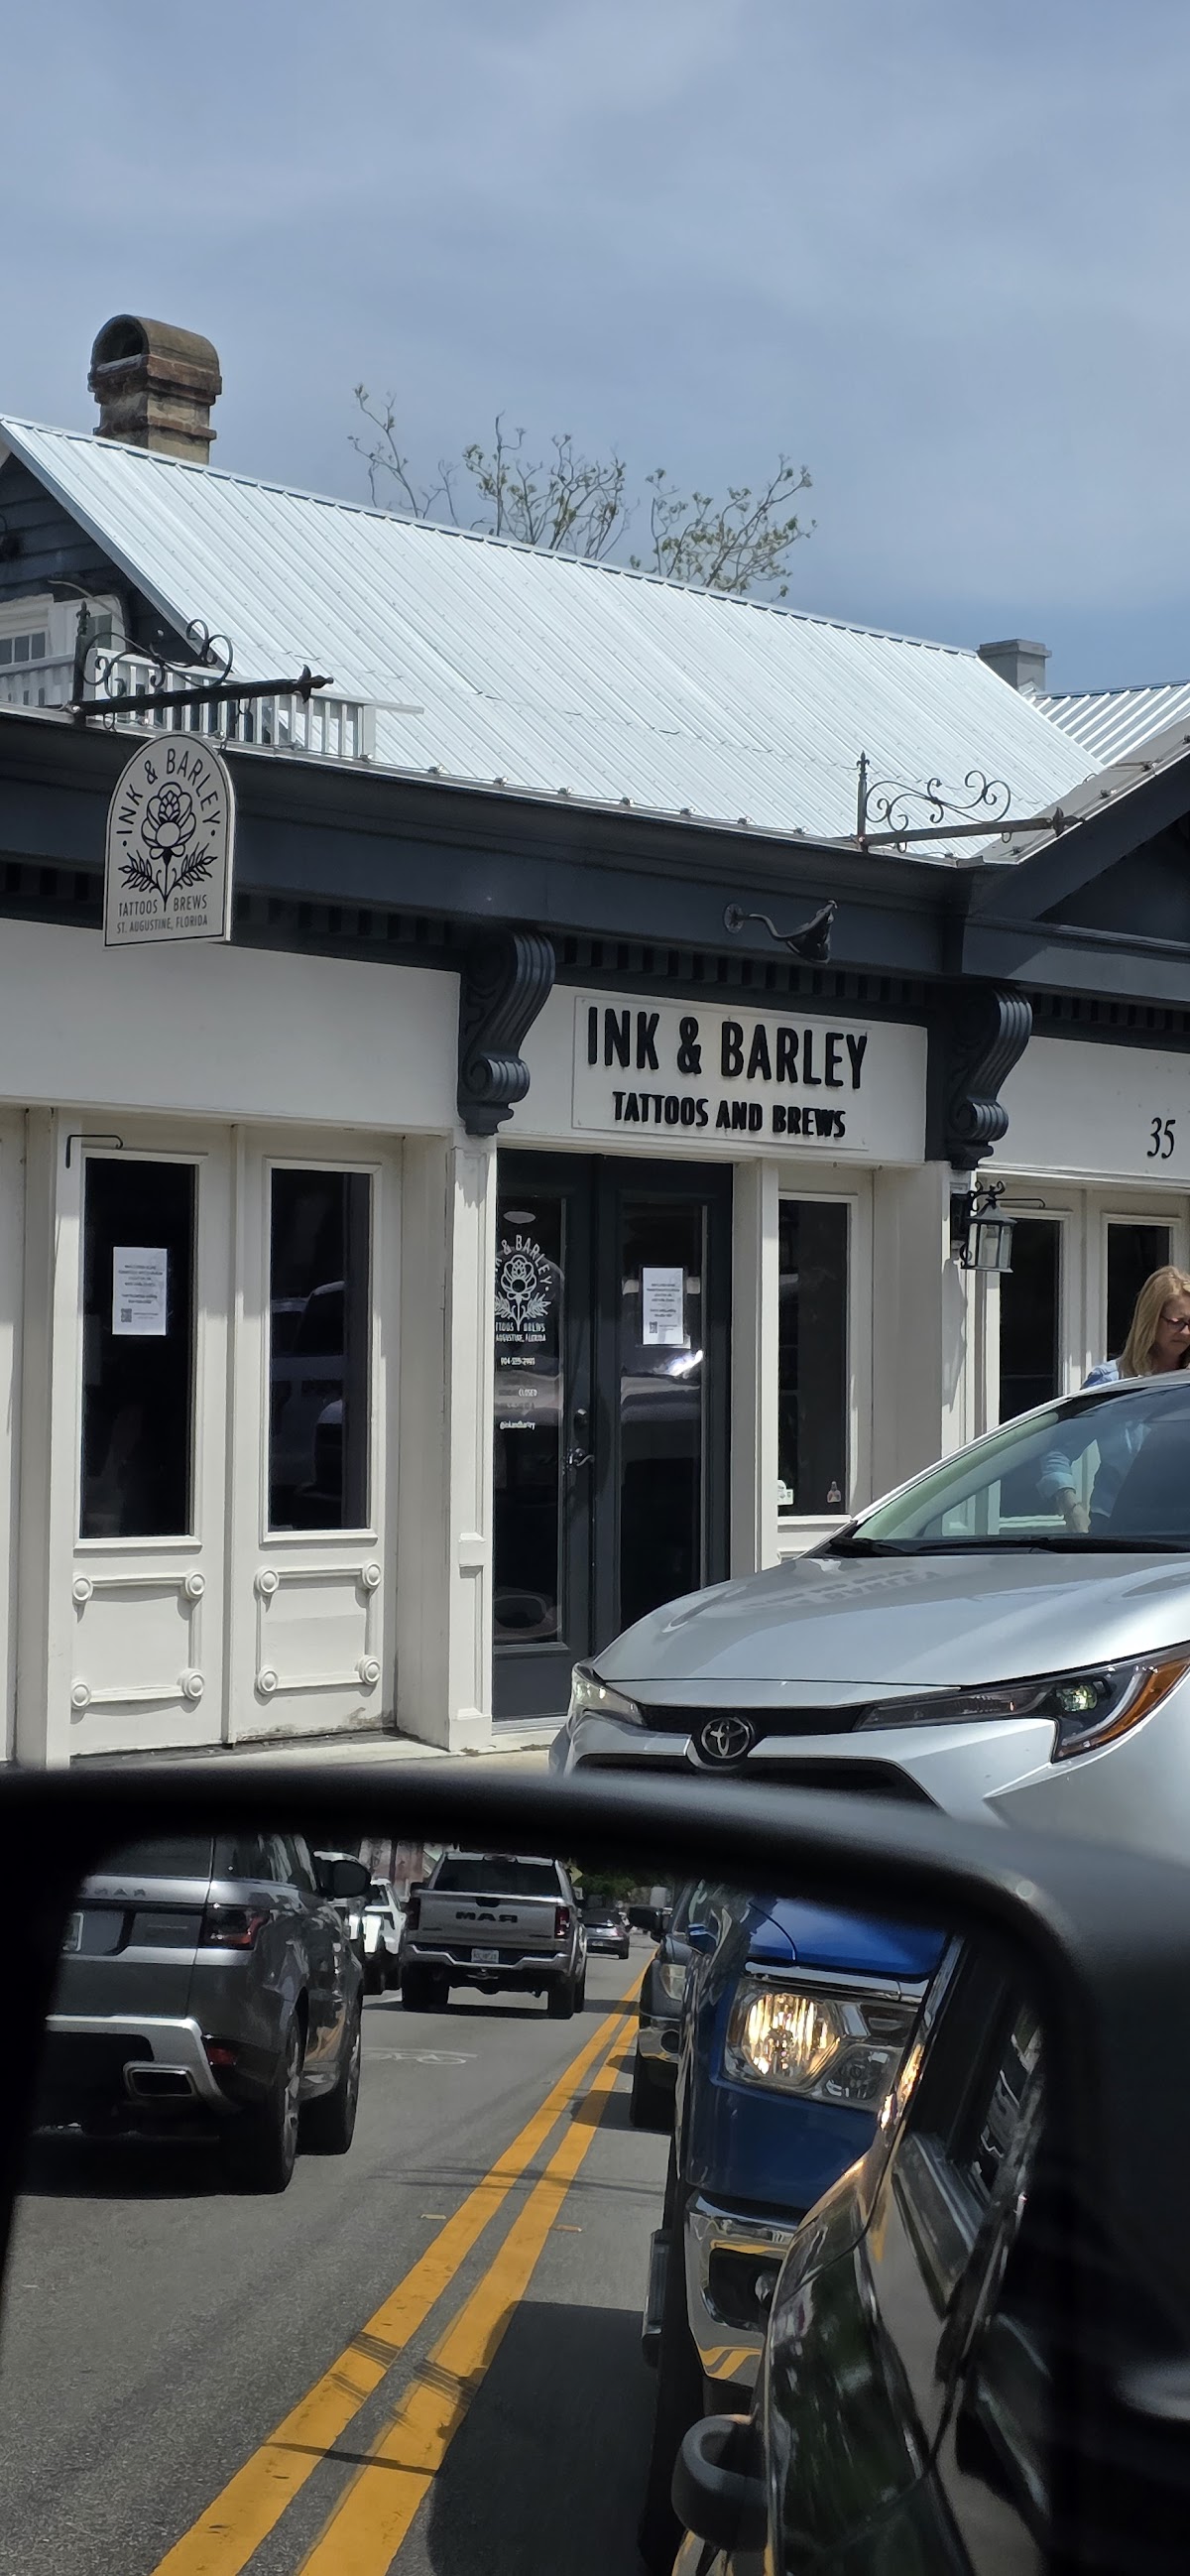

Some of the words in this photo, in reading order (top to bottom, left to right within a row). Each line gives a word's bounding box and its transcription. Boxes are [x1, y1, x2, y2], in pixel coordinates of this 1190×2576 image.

[116, 784, 143, 834] INK
[144, 760, 158, 785] &
[166, 748, 221, 824] BARLEY
[117, 922, 128, 933] ST.
[129, 918, 174, 931] AUGUSTINE,
[176, 915, 207, 928] FLORIDA
[119, 900, 158, 918] TATTOOS
[174, 895, 207, 912] BREWS
[588, 1006, 659, 1070] INK
[677, 1017, 702, 1074] &
[721, 1021, 868, 1089] BARLEY
[612, 1091, 709, 1127] TATTOOS
[715, 1100, 763, 1132] AND
[772, 1104, 846, 1139] BREWS
[1146, 1117, 1176, 1160] 35
[501, 1239, 512, 1256] &
[516, 1234, 552, 1285] BARLEY
